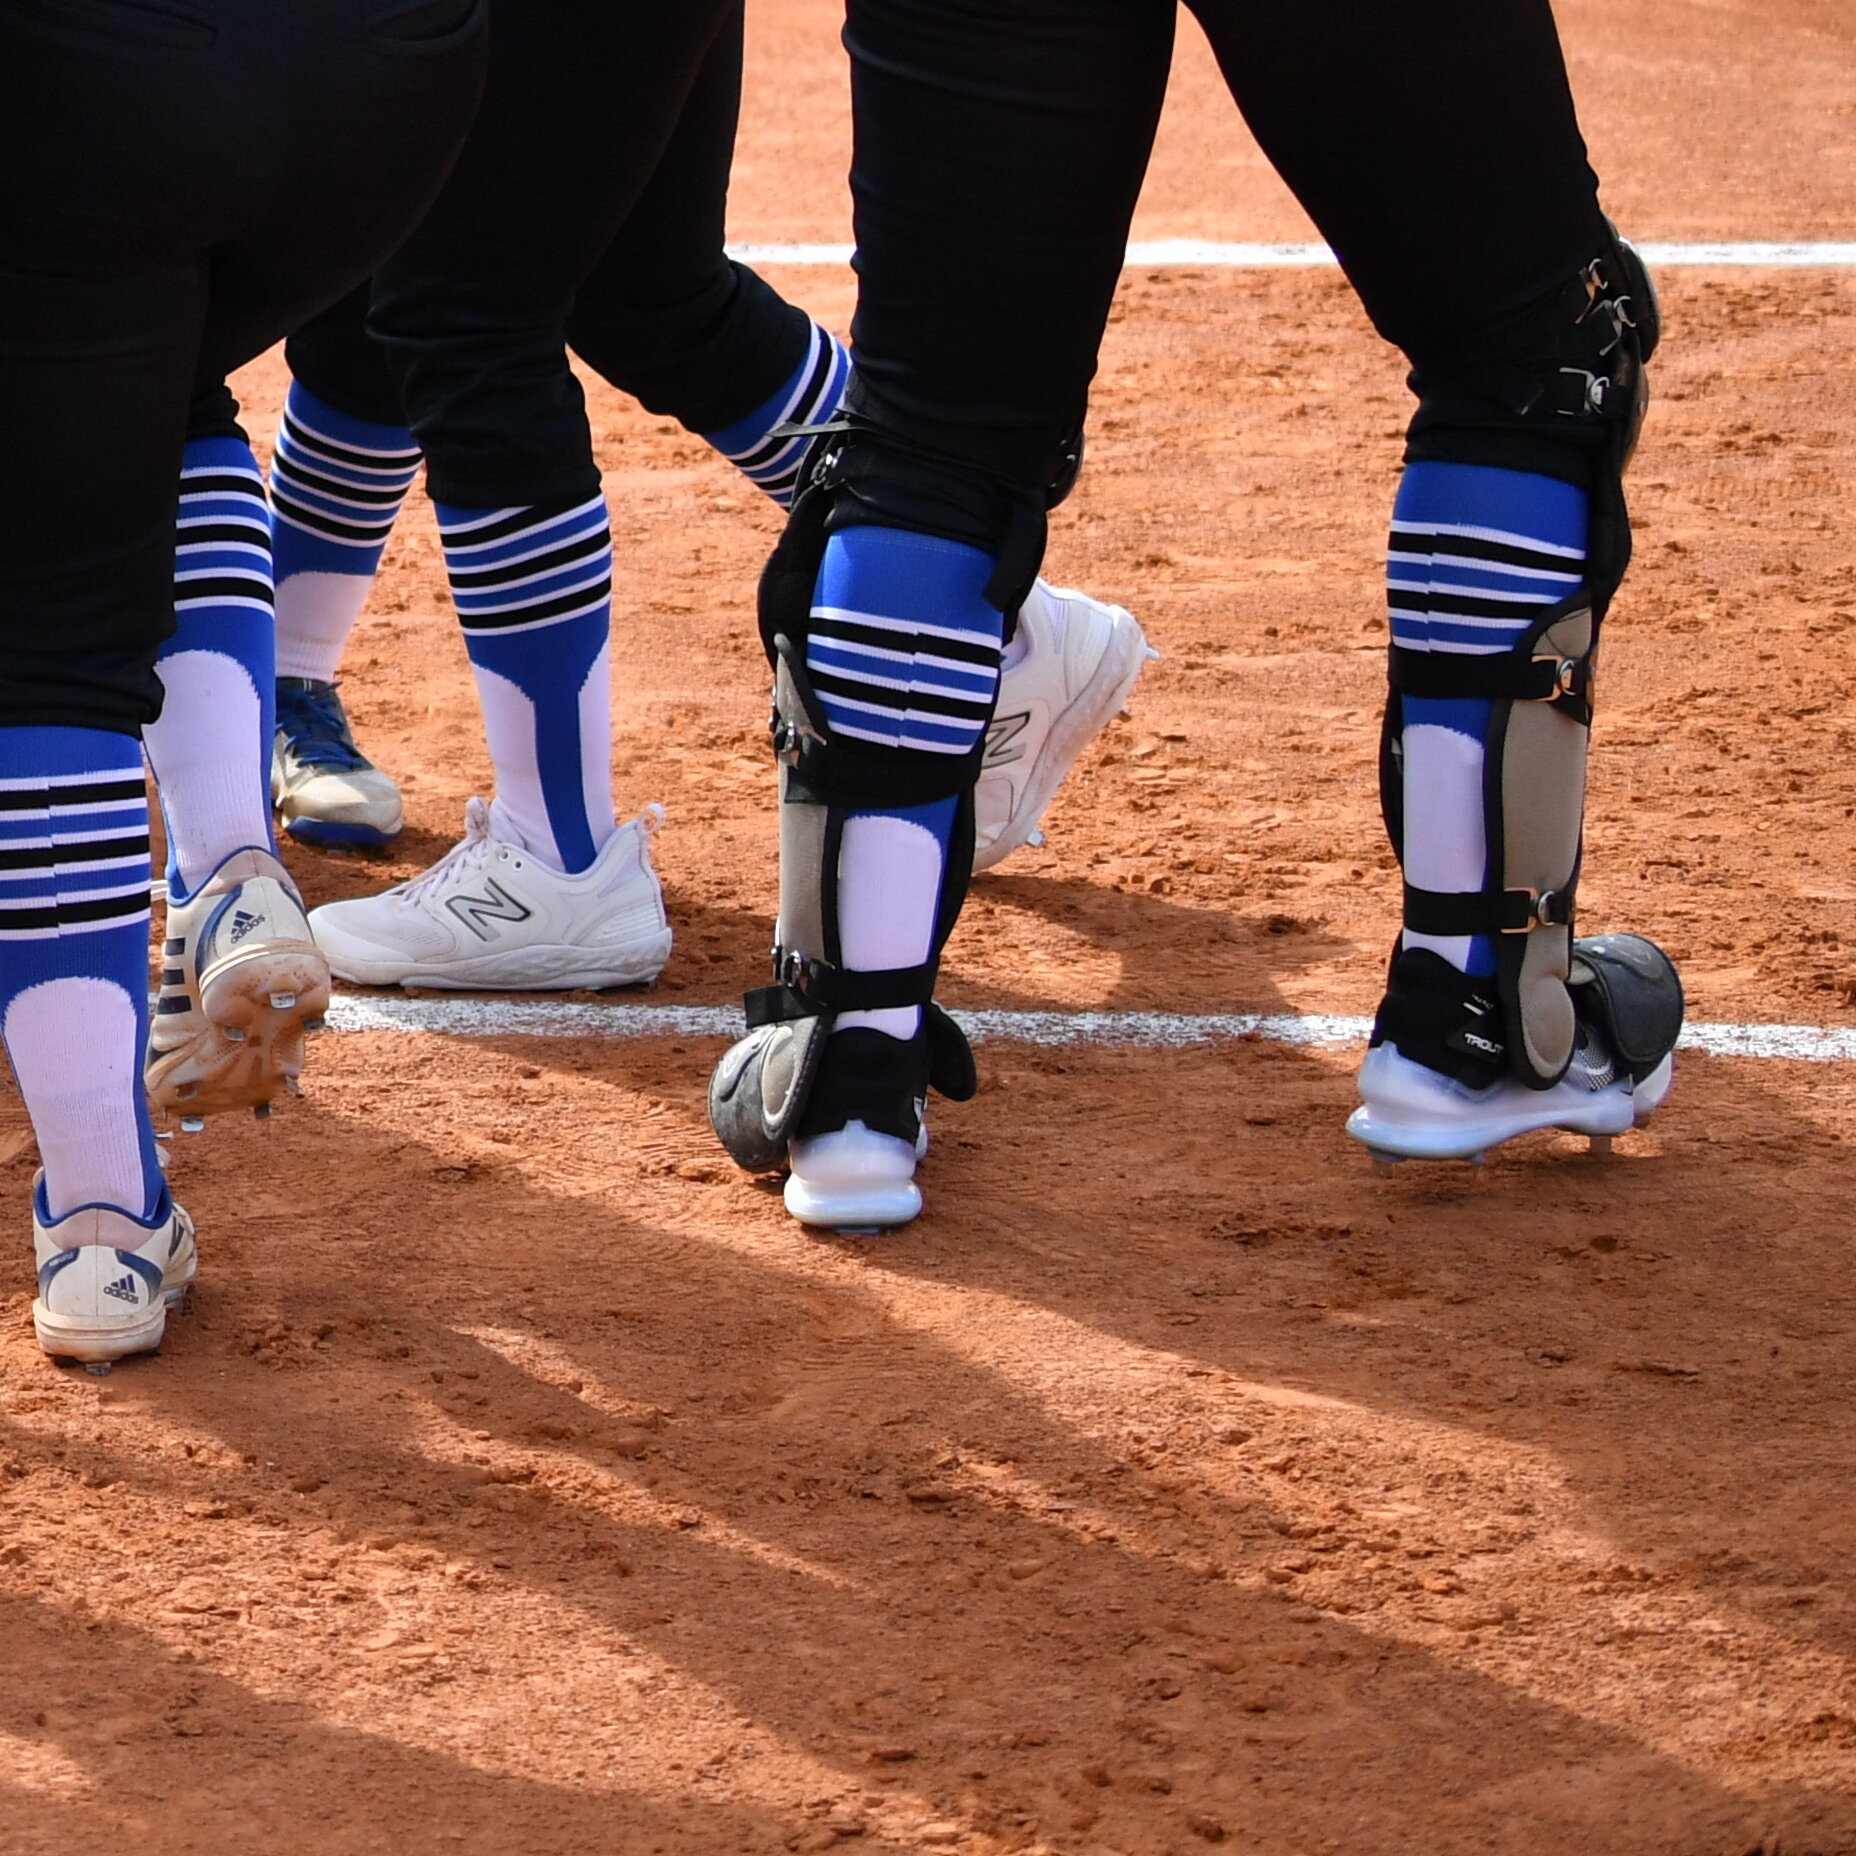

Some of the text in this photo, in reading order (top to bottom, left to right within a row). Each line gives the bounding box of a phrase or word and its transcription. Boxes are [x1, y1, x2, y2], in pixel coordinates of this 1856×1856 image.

[230, 914, 266, 945] adidas
[1464, 1032, 1505, 1055] TROUT
[103, 1286, 139, 1305] adidas
